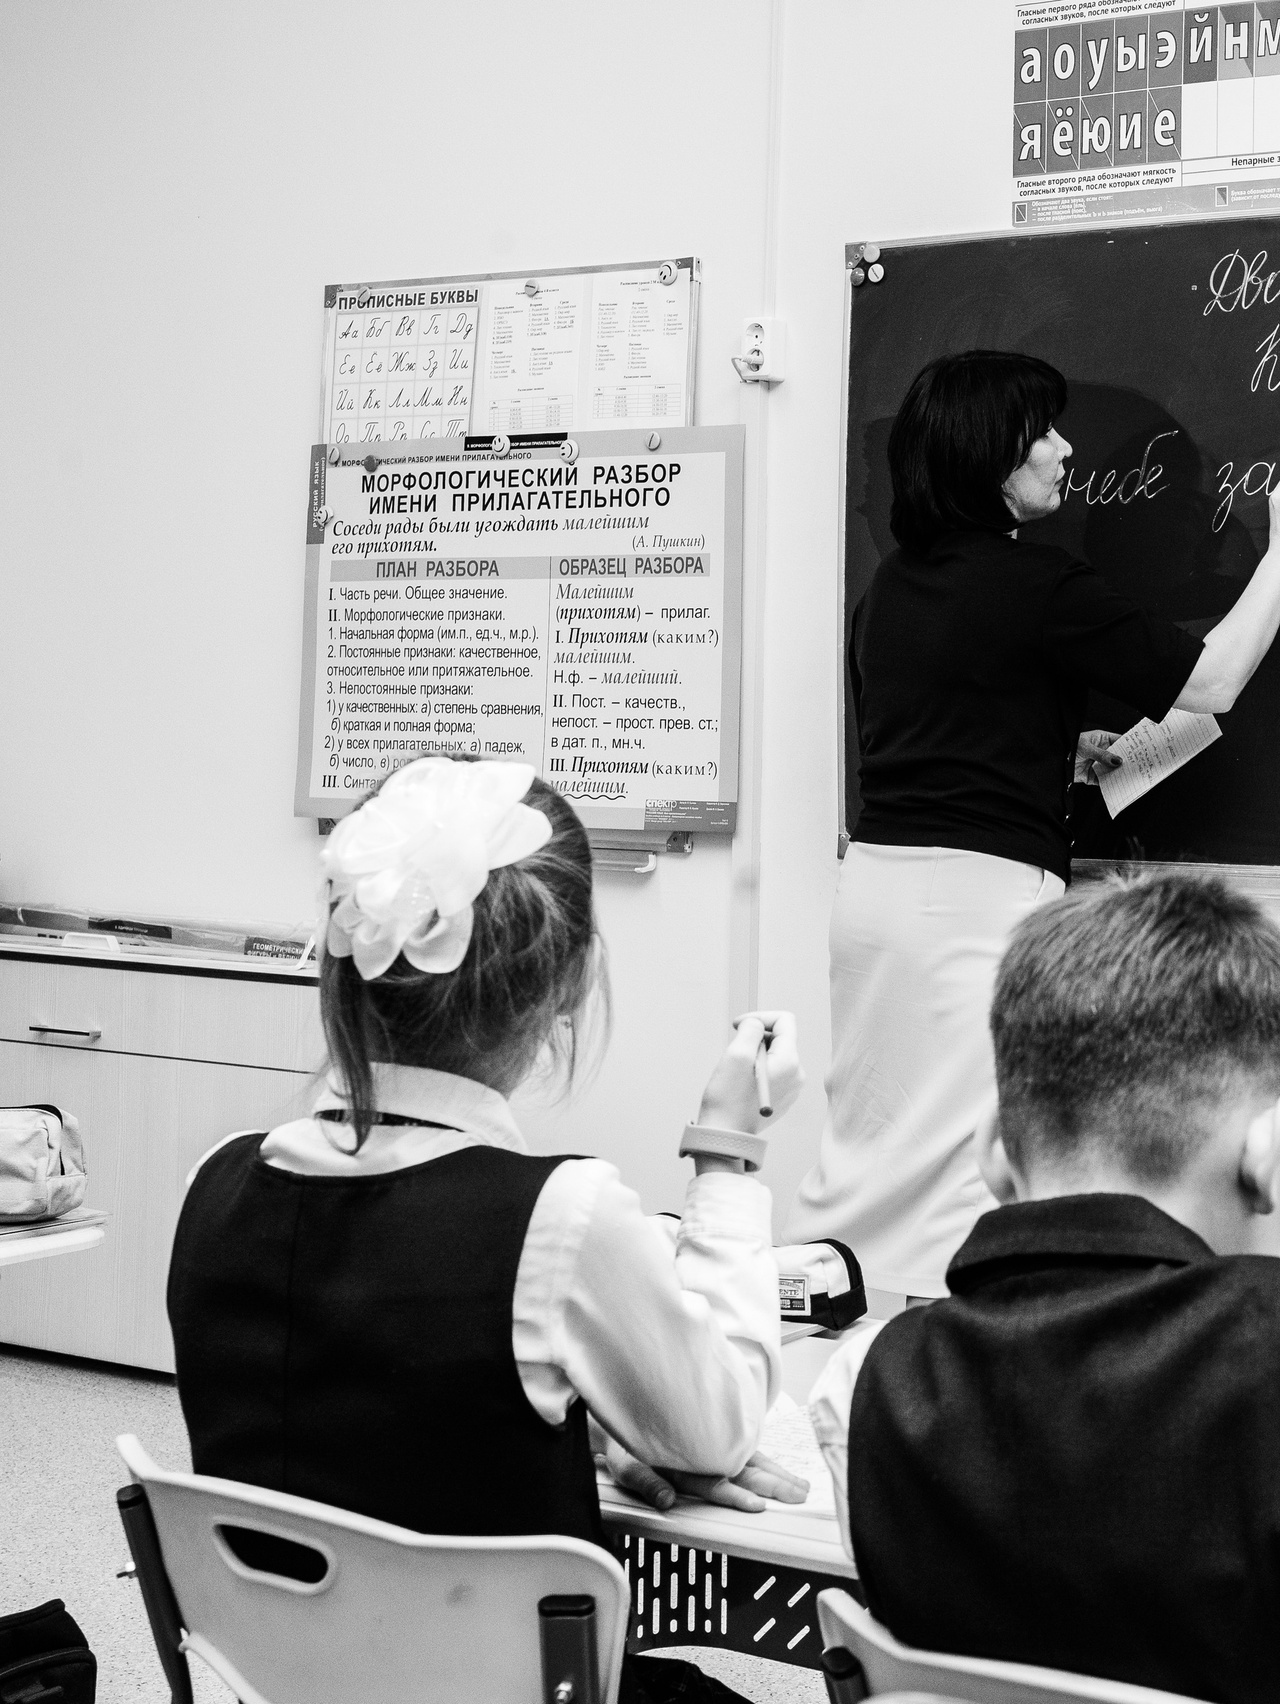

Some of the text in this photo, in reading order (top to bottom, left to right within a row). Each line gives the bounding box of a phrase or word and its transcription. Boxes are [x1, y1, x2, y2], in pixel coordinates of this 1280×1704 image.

[1017, 9, 1047, 17] Гласные
[1048, 4, 1077, 14] первого
[1022, 15, 1059, 25] согласных
[1061, 12, 1086, 21] звуков,
[1088, 9, 1109, 17] после
[1111, 5, 1141, 14] которых
[1144, 0, 1176, 10] следуют
[1231, 156, 1275, 166] Непарные
[1017, 167, 1176, 189] Гласные второго ряда обозначают мягкость
[1019, 176, 1173, 197] согласных звуков, после которых следуют
[338, 290, 478, 310] ПРОПИСНЫЕ БУКВЫ
[408, 455, 434, 463] РАЗБОР
[435, 454, 460, 462] ИМЕНИ
[361, 463, 681, 493] МОРФОЛОГИЧЕСКИЙ РАЗБОР
[369, 487, 670, 514] ИМЕНИ ПРИЛАГАТЕЛЬНОГО
[333, 514, 650, 539] Соседи рады были угождать малейшим
[331, 540, 437, 558] его прихотям.
[632, 534, 705, 552] (А. Пушкин)
[376, 560, 500, 578] ПЛАН РАЗБОРА
[559, 557, 704, 578] ОБРАЗЕЦ РАЗБОРА
[339, 587, 370, 600] Часть
[374, 588, 401, 603] речи.
[405, 586, 445, 601] Общее
[448, 587, 508, 599] значение.
[556, 583, 634, 600] Малейшим
[344, 608, 444, 624] Морфологические
[448, 609, 506, 624] признаки.
[556, 605, 710, 625] (прихотям) прилаг.
[328, 627, 337, 640] 1.
[339, 626, 395, 640] Начальная
[397, 626, 434, 642] форма
[476, 628, 506, 642] ед.ч.,
[509, 626, 539, 643] м.р.).
[568, 627, 648, 649] Прихотям
[652, 629, 719, 648] (каким?)
[328, 645, 541, 661] 2. Постоянные признаки: качественное,
[554, 649, 635, 664] малейшим.
[327, 665, 534, 679] относительное или притяжательное.
[553, 669, 682, 687] Н.ф. малейший.
[327, 681, 474, 698] 3. Непостоянные признаки:
[327, 700, 544, 718] 1) у качественных: а) степень сравнения,
[572, 694, 606, 708] Пост.
[625, 697, 686, 711] качеств.,
[331, 717, 476, 735] б) краткая и полная форма;
[552, 717, 718, 732] непост. прост. прев. ст.;
[324, 736, 525, 755] 2) у всех прилагательных: а) падеж,
[551, 737, 645, 750] в дат. п., мн.ч.
[342, 757, 377, 770] число,
[571, 756, 648, 778] Прихотям
[652, 760, 718, 780] (каким?)
